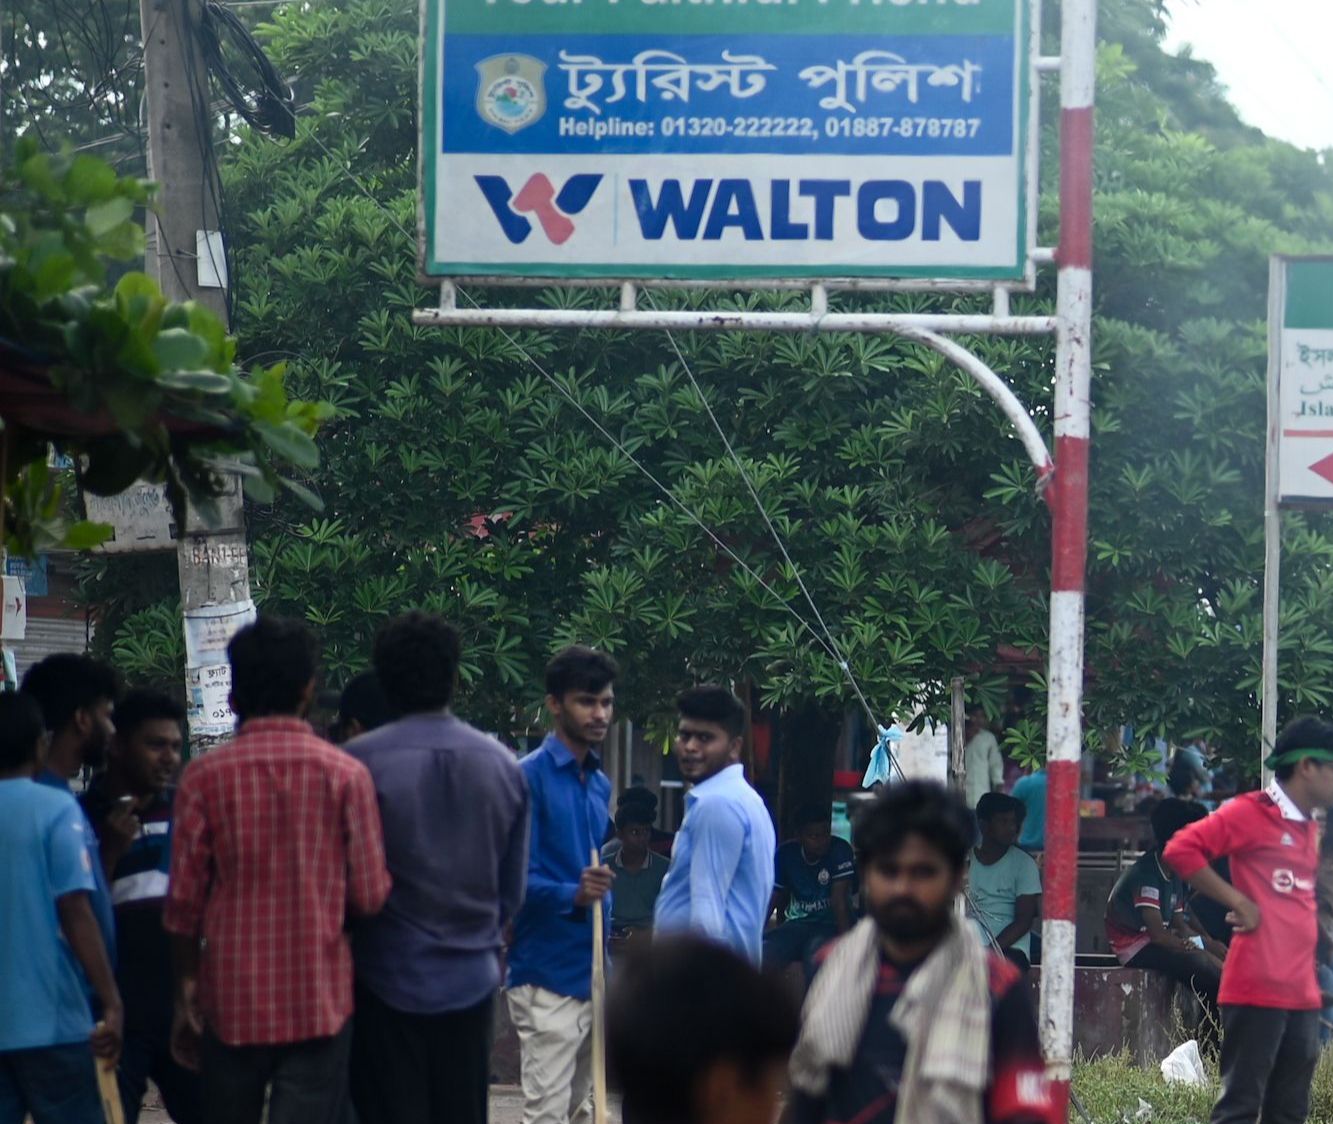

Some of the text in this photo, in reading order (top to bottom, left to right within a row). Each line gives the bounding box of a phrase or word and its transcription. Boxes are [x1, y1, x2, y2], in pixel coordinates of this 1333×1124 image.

[556, 49, 982, 114] ট্যুরিস্ট পুলিশ
[559, 116, 982, 141] Helpline: 01320-222222, 01887-878787
[627, 178, 982, 242] WALTON
